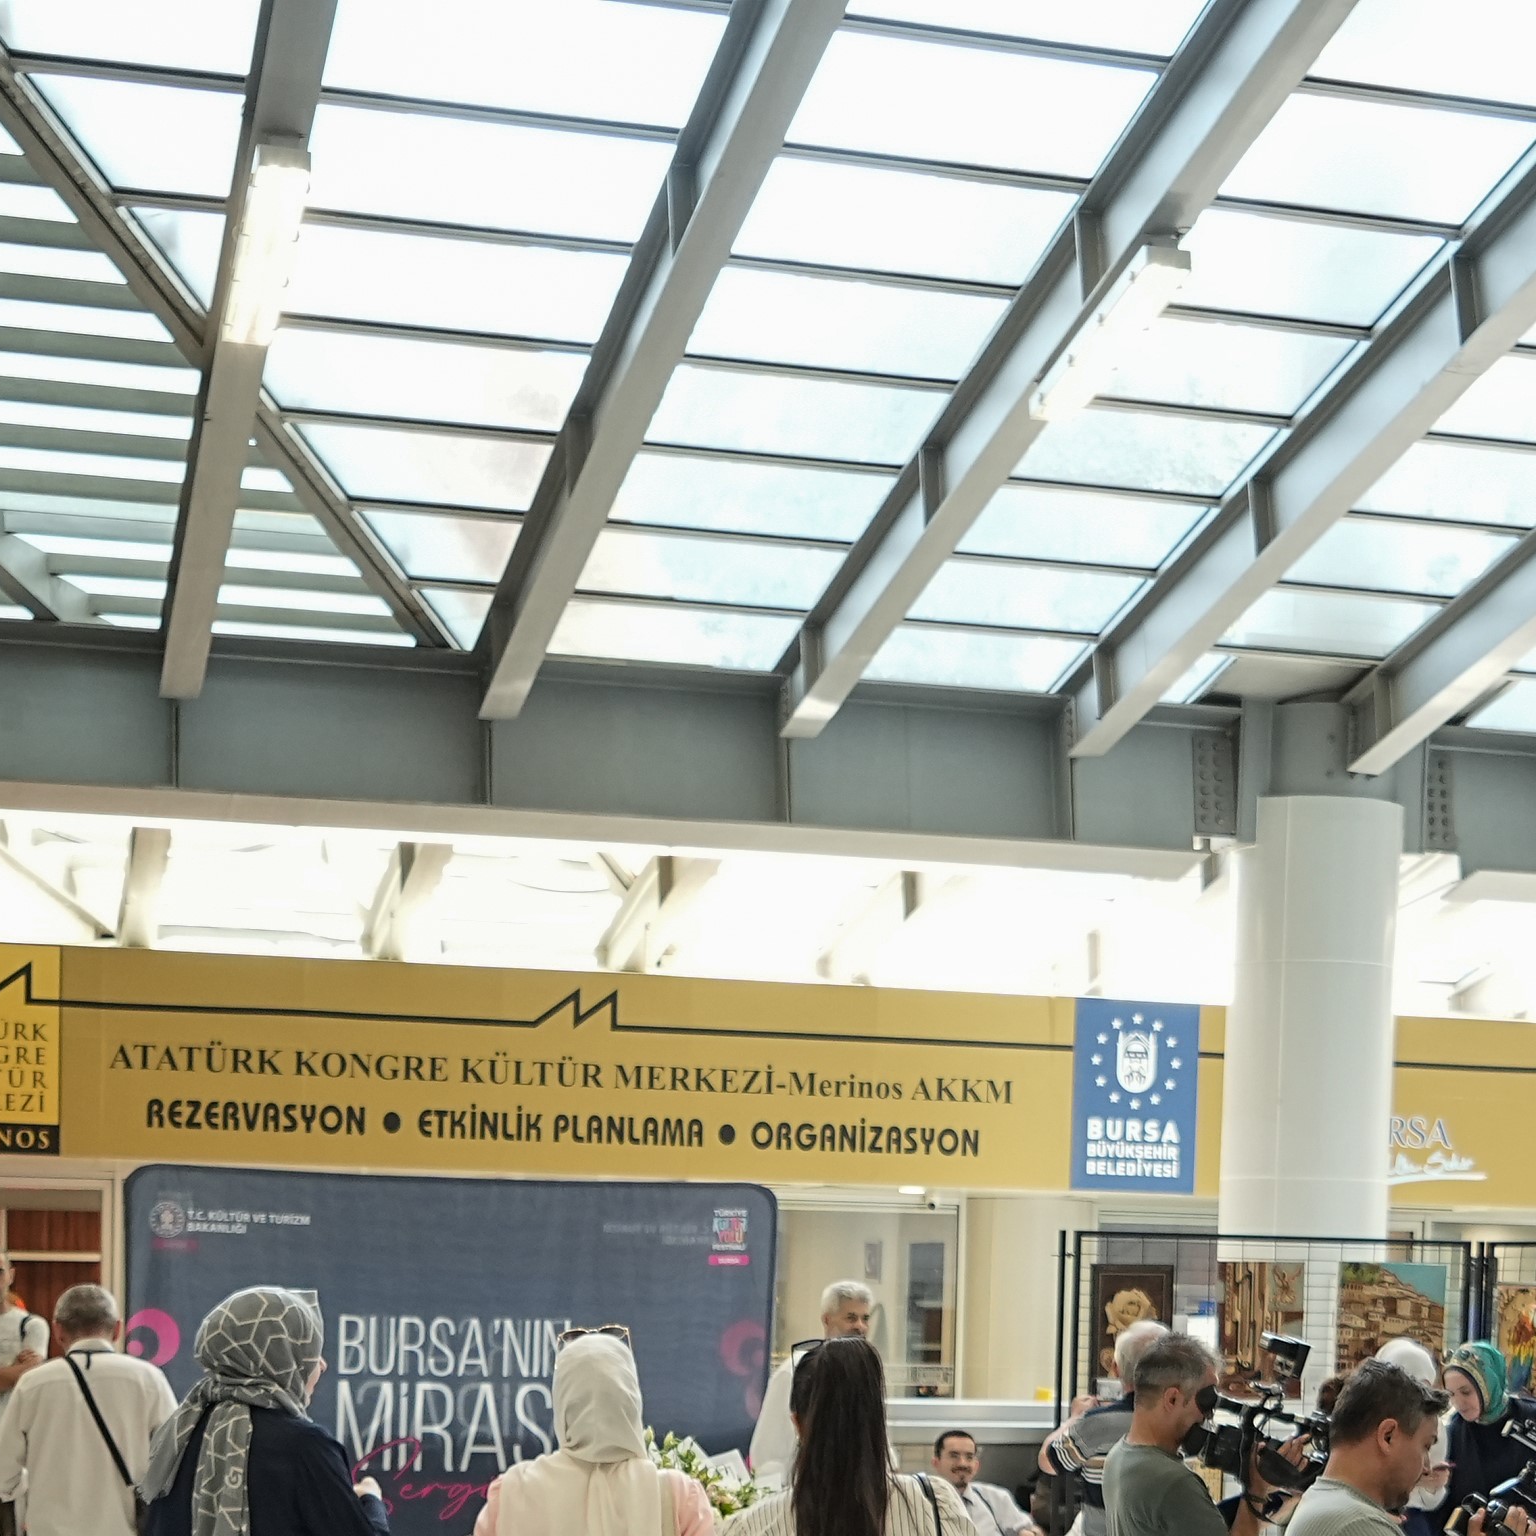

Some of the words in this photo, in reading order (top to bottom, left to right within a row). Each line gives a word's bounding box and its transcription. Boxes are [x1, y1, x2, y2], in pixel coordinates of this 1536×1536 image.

[109, 1040, 283, 1077] ATATÜRK
[294, 1050, 450, 1083] KONGRE
[459, 1050, 603, 1089] KÜLTÜR
[909, 1077, 1013, 1105] AKKM
[146, 1098, 366, 1136] REZERVASYON
[418, 1103, 542, 1143] ETKİNLİK
[553, 1113, 703, 1149] PLANLAMA
[750, 1117, 980, 1158] ORGANİZASYON
[1087, 1116, 1180, 1143] BURSA
